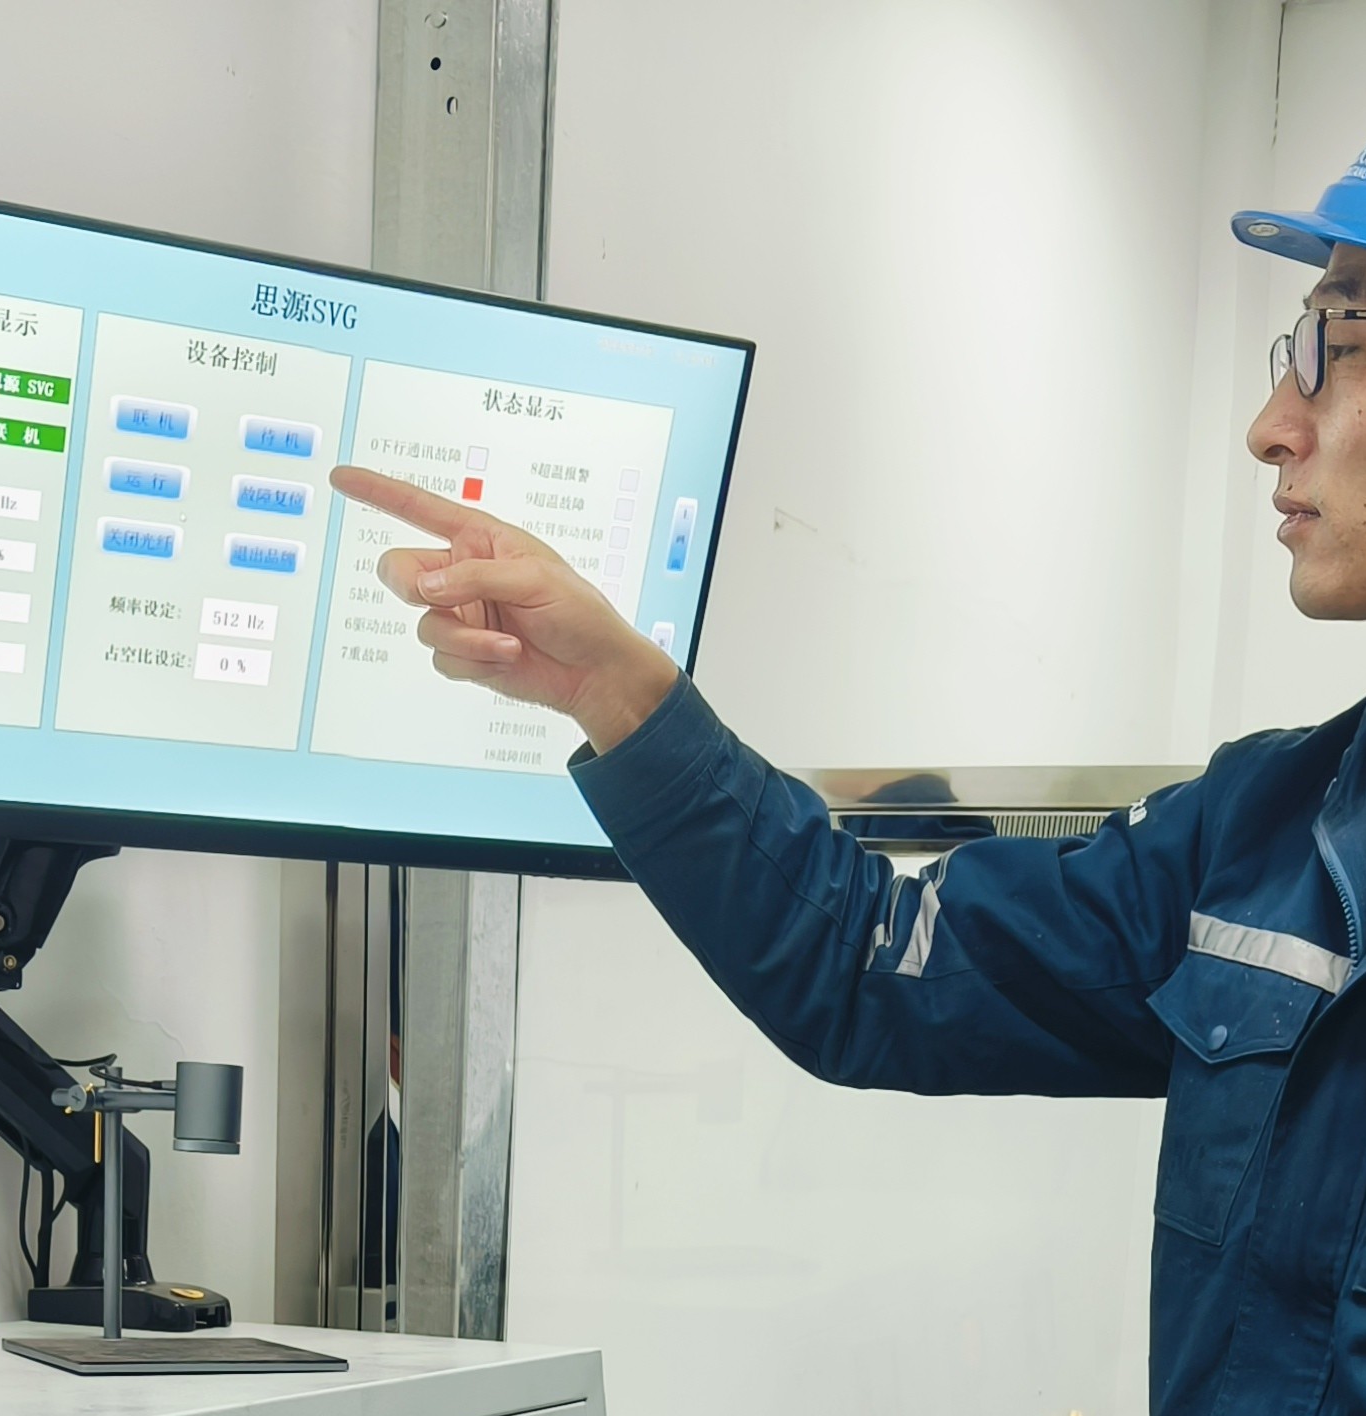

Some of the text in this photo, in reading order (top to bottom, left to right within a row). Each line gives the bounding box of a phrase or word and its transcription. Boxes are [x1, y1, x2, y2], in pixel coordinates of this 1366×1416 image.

[250, 282, 359, 330] 思源SVG
[186, 338, 278, 378] 设备控制
[26, 378, 55, 398] SVG
[482, 387, 566, 422] 状态显示
[0, 494, 18, 511] Hz
[212, 611, 265, 631] 512 Hz
[220, 656, 229, 672] 0
